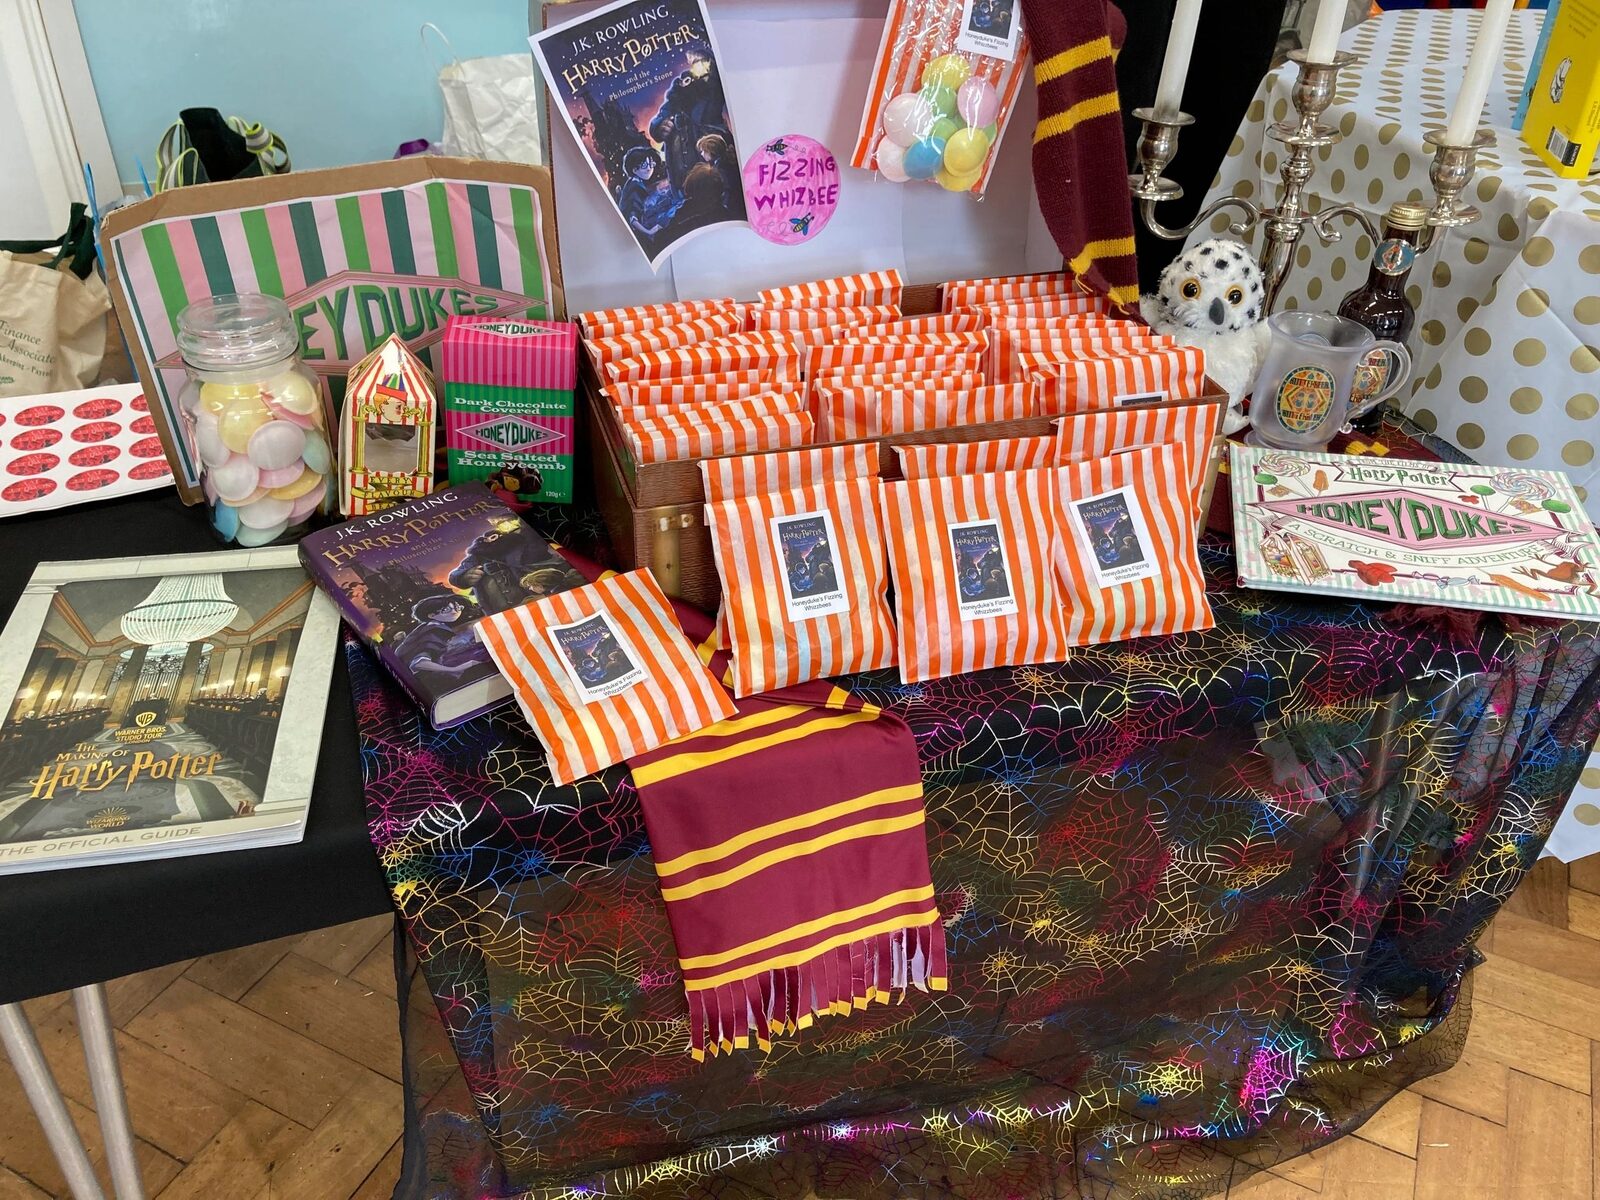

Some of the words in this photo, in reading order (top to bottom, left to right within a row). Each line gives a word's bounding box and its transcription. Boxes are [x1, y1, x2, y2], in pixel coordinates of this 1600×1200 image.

[595, 5, 669, 43] ROWLING
[562, 53, 627, 94] HARRY
[623, 24, 699, 67] POTTER
[626, 74, 638, 84] and
[639, 70, 650, 79] the
[609, 79, 653, 101] Philosopher's
[654, 71, 673, 83] Stone
[759, 156, 835, 186] FIZZING
[754, 184, 838, 211] WHIZBEE
[291, 284, 499, 360] EYDUKES
[454, 397, 492, 407] Dark
[495, 400, 567, 410] Chocolate
[480, 406, 540, 415] Covered
[475, 421, 549, 446] HONEYDUKES
[457, 457, 566, 471] Honeycomb
[464, 451, 497, 460] Sea
[501, 452, 557, 463] Salted
[370, 476, 410, 484] EVERY
[1346, 467, 1395, 481] Harry
[1396, 469, 1448, 486] Potter
[335, 525, 364, 540] J.K.
[366, 492, 459, 528] ROWLING
[1296, 497, 1532, 541] HONEYDUKES
[322, 530, 414, 568] HARRY
[405, 500, 500, 537] POTTER
[410, 541, 427, 551] and
[1288, 522, 1300, 531] A
[1304, 527, 1379, 557] SCRATCH
[1385, 551, 1397, 560] &
[1403, 553, 1451, 565] SNIFF
[1457, 544, 1546, 565] ADVENTURE
[792, 596, 823, 607] Honeyduke's
[824, 593, 843, 601] Fizzing
[804, 602, 831, 611] Whizzbees
[961, 601, 994, 611] Honeyduke's
[995, 598, 1014, 606] Fizzing
[974, 607, 1002, 615] Whizzbees
[587, 679, 622, 695] Honeyduke's
[623, 669, 642, 683] Fizzing
[603, 681, 633, 696] Whizzbees
[115, 728, 145, 737] WARNER
[116, 734, 142, 743] STUDIO
[144, 732, 162, 740] TOUR
[74, 742, 98, 752] THE
[56, 752, 109, 762] MAKING
[111, 749, 130, 757] OF
[29, 759, 127, 800] Harry
[125, 750, 223, 793] Potter
[86, 815, 131, 825] WIZARDING
[89, 821, 125, 829] WORLD
[0, 845, 37, 856] THE
[43, 835, 133, 851] OFFICIAL
[141, 826, 203, 840] GUIDE
